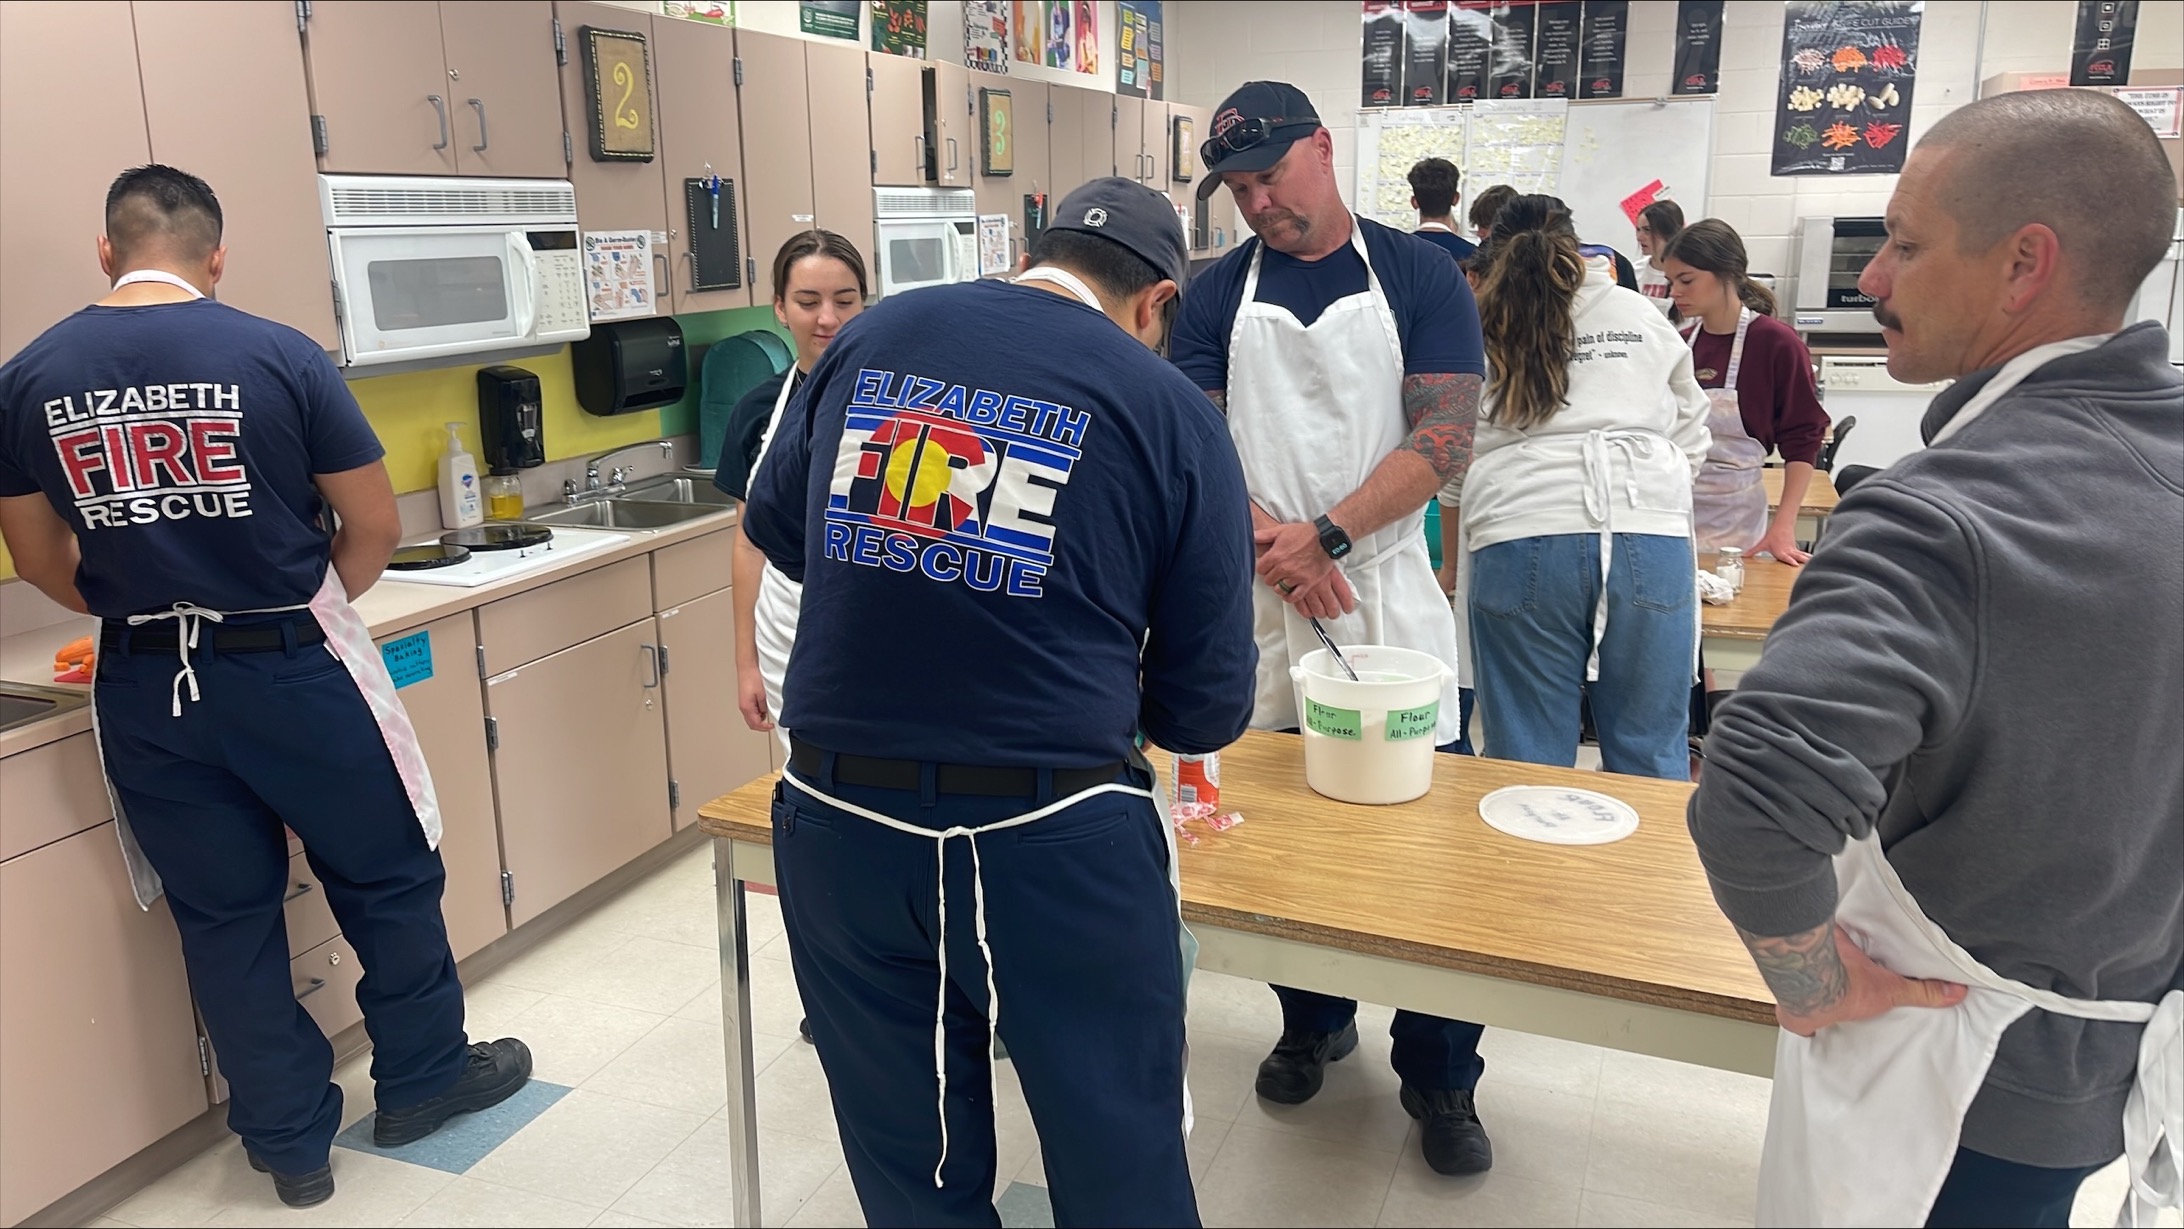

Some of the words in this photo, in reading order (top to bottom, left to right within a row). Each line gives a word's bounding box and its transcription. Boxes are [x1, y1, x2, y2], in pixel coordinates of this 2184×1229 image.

[1860, 18, 1879, 27] CUT
[1881, 17, 1910, 26] GUIDE
[614, 61, 639, 129] 2
[995, 110, 1006, 156] 3
[1577, 332, 1595, 347] pain
[1596, 331, 1605, 343] of
[1606, 330, 1643, 345] discipline
[44, 383, 240, 427] ELIZABETH
[852, 368, 1091, 447] ELIZABETH
[51, 418, 247, 499] FIRE
[828, 411, 1075, 553] FIRE
[79, 491, 253, 530] RESCUE
[824, 521, 1047, 598] RESCUE
[1401, 711, 1430, 723] Flour
